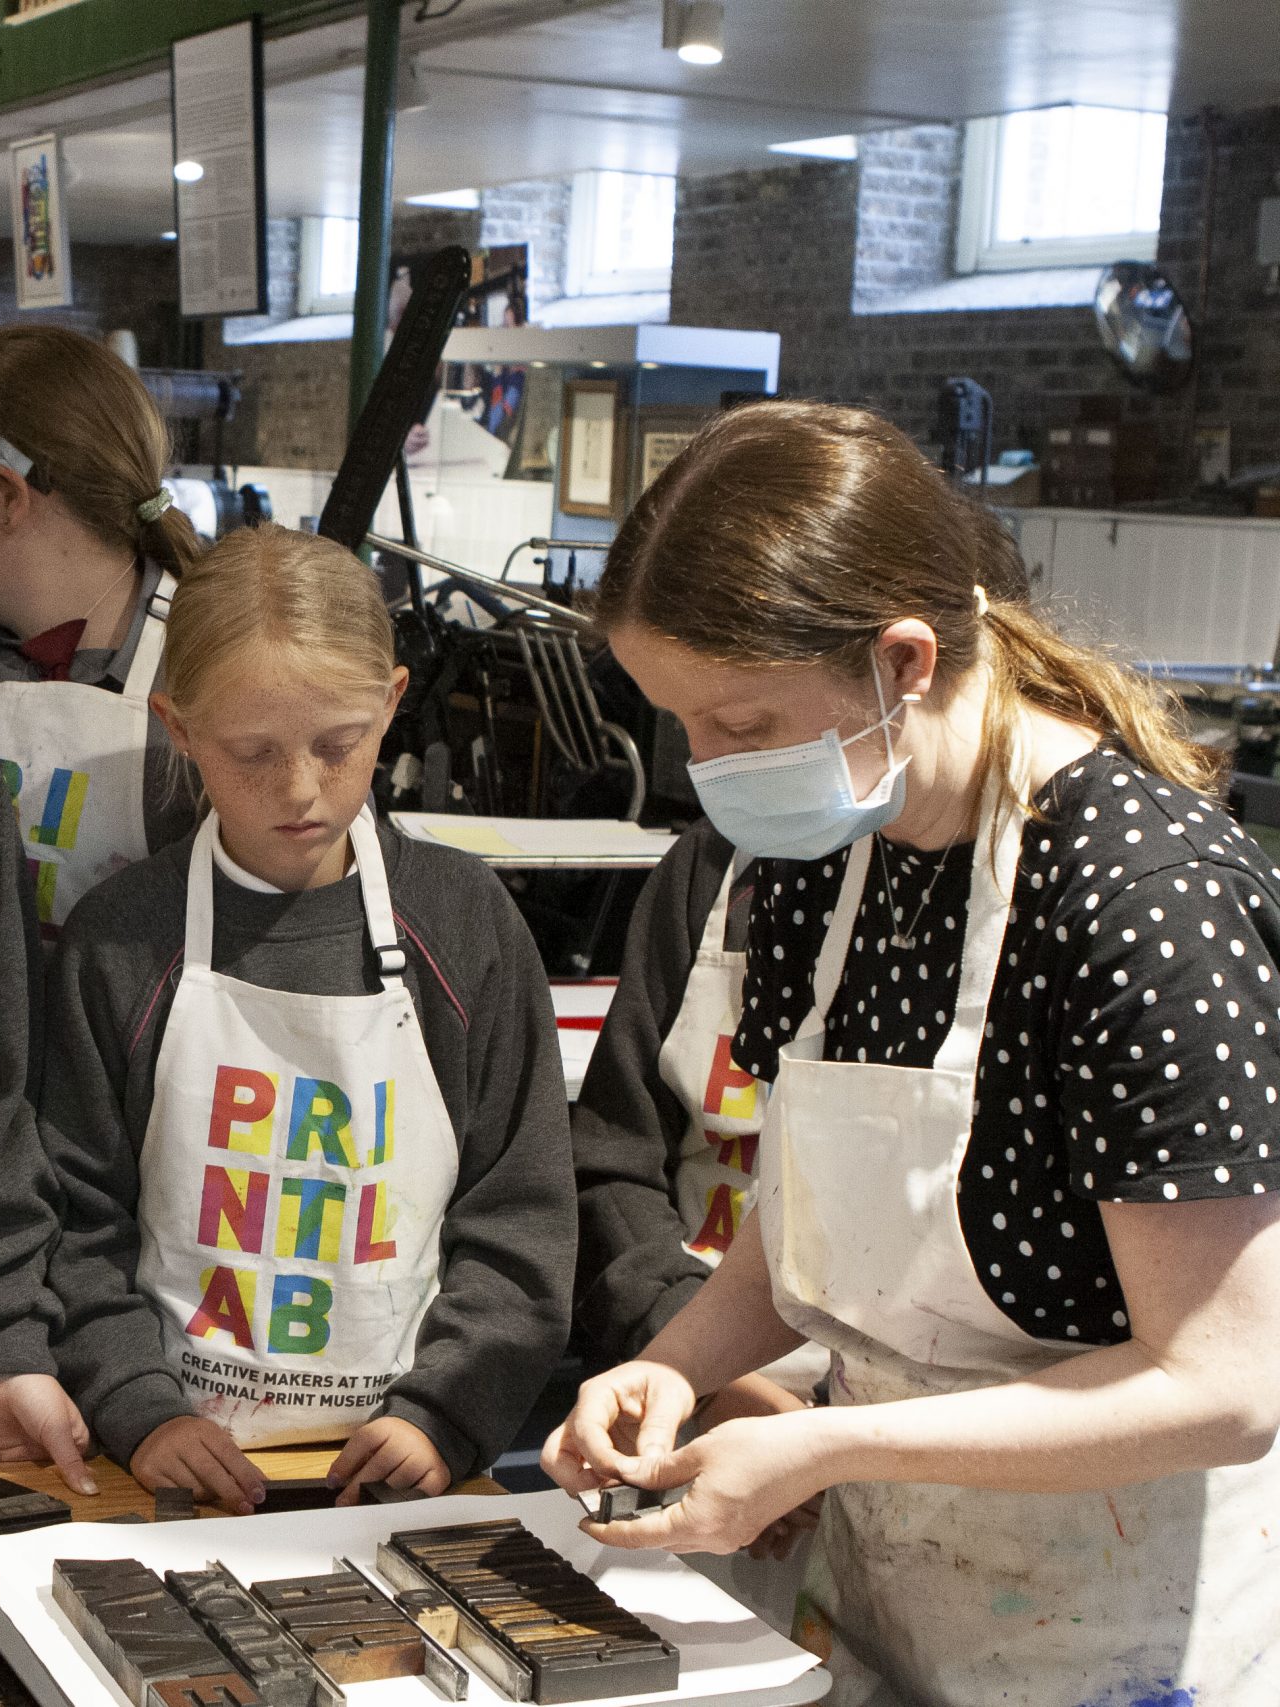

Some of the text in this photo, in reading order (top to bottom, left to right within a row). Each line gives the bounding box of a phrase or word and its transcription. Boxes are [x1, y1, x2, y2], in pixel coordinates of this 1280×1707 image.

[197, 1164, 397, 1266] NTL
[185, 1265, 333, 1356] AB
[181, 1352, 396, 1389] CREATIVE MAKERS AT THE
[181, 1369, 260, 1402] NATIONAL
[264, 1391, 316, 1406] PRINT
